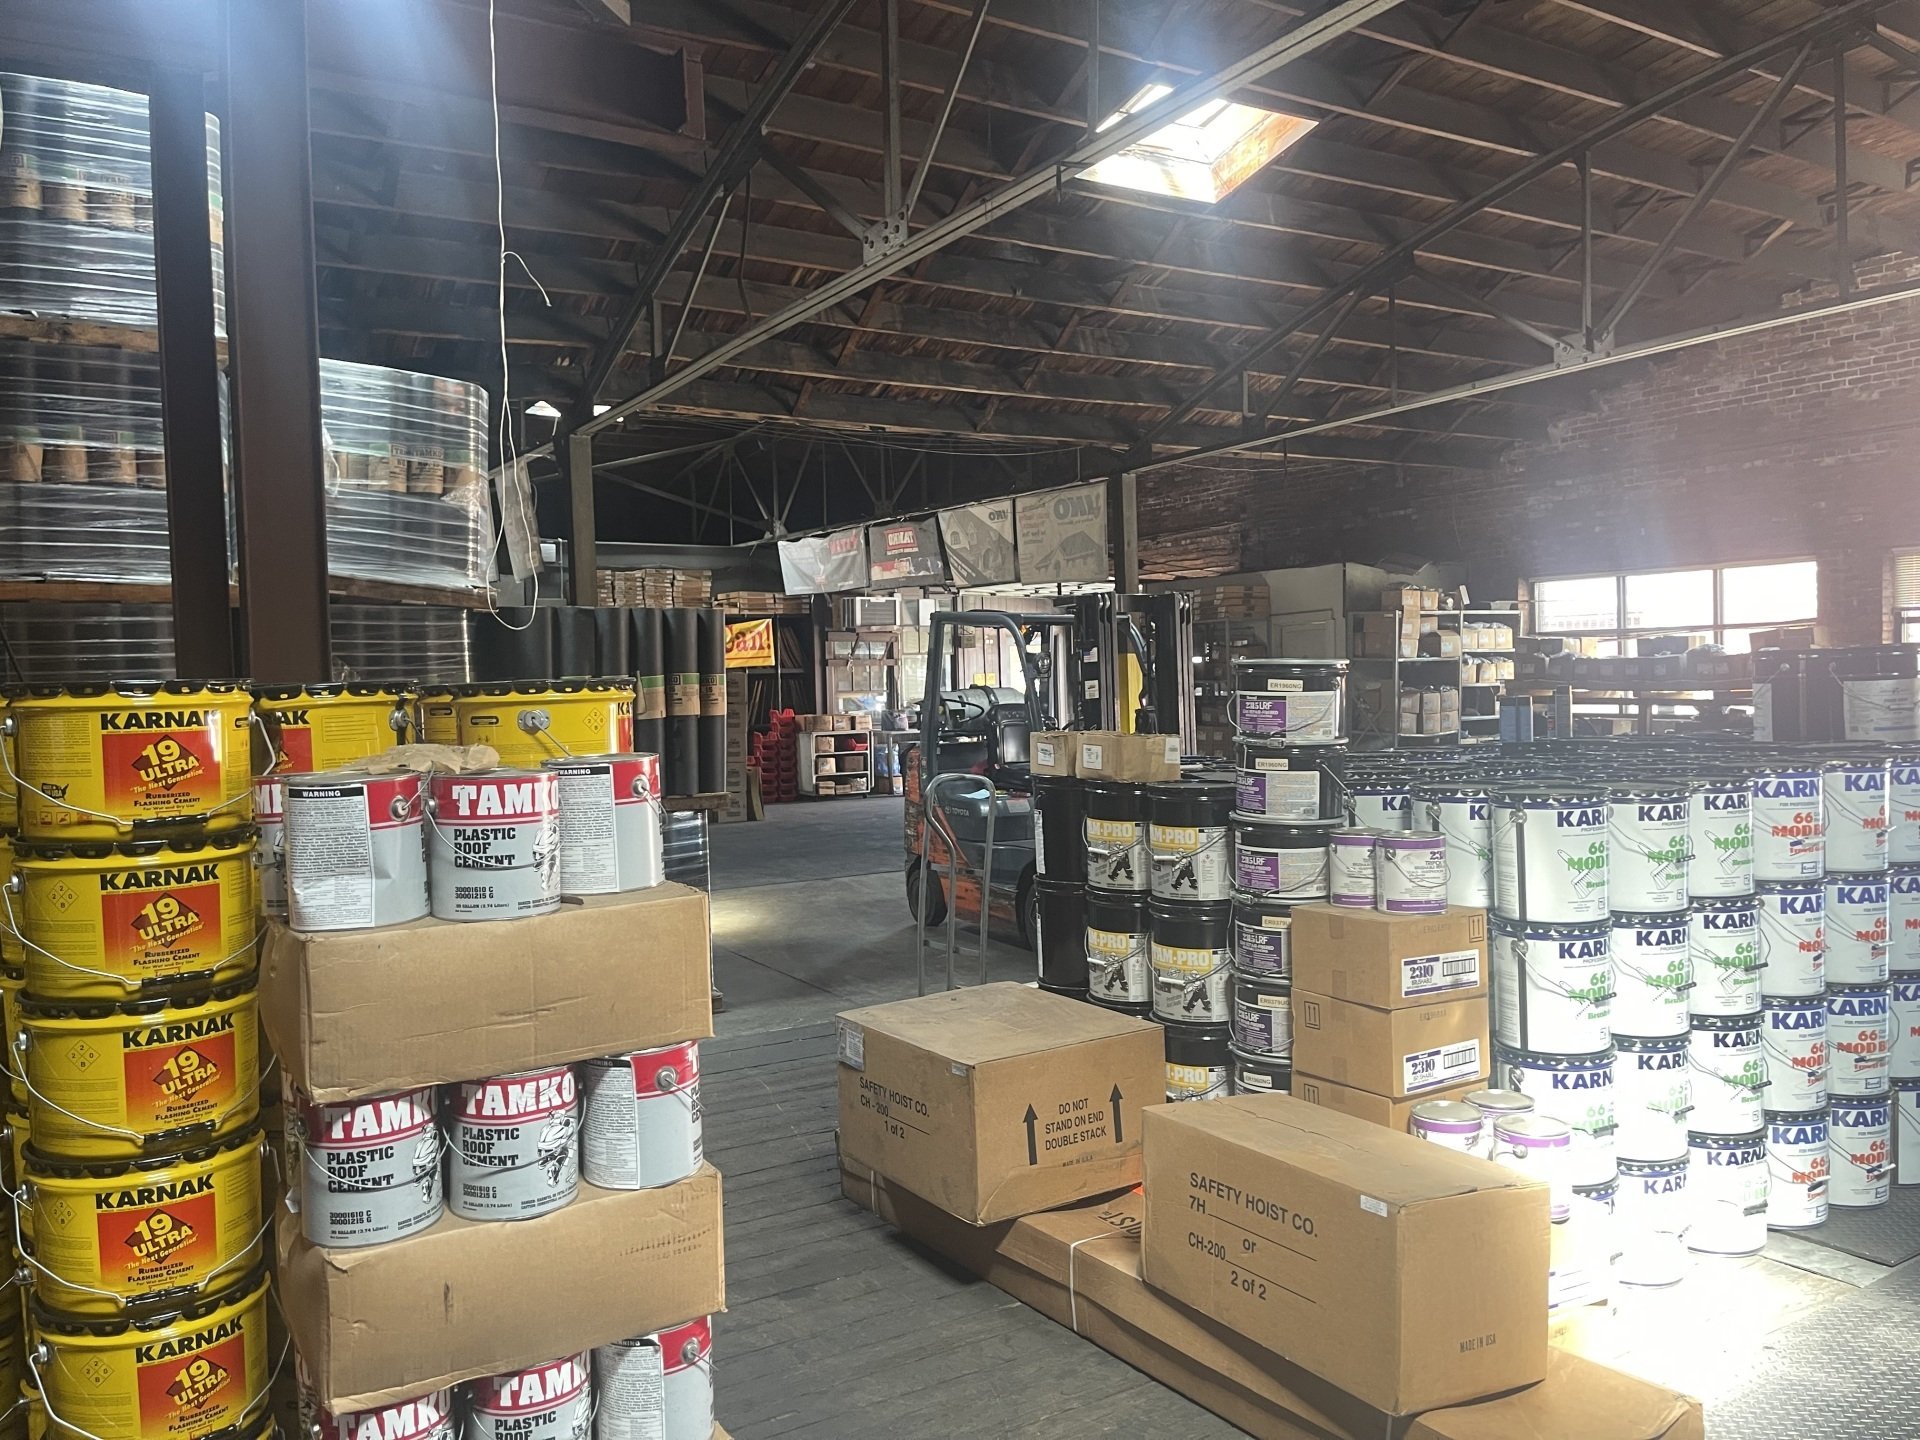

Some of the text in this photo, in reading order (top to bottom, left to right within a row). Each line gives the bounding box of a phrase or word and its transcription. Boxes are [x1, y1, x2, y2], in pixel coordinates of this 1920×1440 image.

[142, 739, 180, 766] 19
[139, 755, 200, 782] ULTRA
[173, 797, 201, 805] CEMENT
[302, 790, 341, 798] WARNING
[952, 807, 970, 816] TOYOTA
[1793, 811, 1814, 824] 66
[454, 827, 516, 841] PLASTIC
[1734, 823, 1750, 835] 66
[454, 842, 491, 855] ROOF
[1588, 840, 1605, 856] 66
[1669, 834, 1685, 848] 66
[454, 854, 516, 868] CEMENT
[100, 863, 220, 890] KARNAK
[141, 897, 180, 923] 19
[139, 913, 200, 940] ULTRA
[1735, 941, 1754, 955] 66
[133, 952, 201, 966] FLASHING CEMENT
[1667, 959, 1685, 973] 66
[1410, 965, 1434, 979] 2310
[1590, 971, 1606, 986] 66
[123, 1012, 235, 1049] KARNAK
[1858, 1029, 1877, 1041] 66
[163, 1050, 200, 1079] 19
[1411, 1059, 1435, 1075] 2310
[1743, 1059, 1759, 1072] 66
[160, 1062, 217, 1095] ULTRA
[462, 1071, 575, 1116] TAMKO
[860, 1076, 930, 1117] SAFETY HOIST CO.
[155, 1102, 218, 1122] FLASHING CEMENT
[1059, 1098, 1089, 1115] DO NOT
[891, 1124, 898, 1136] of
[900, 1127, 905, 1139] 2
[1045, 1111, 1104, 1134] STAND ON END
[462, 1126, 520, 1140] PLASTIC
[1045, 1125, 1107, 1151] DOUBLE STACK
[327, 1146, 395, 1165] PLASTIC
[462, 1139, 495, 1154] ROOF
[1870, 1140, 1886, 1152] 66
[462, 1153, 519, 1167] CEMENT
[1810, 1157, 1825, 1169] 66
[327, 1165, 368, 1179] ROOF
[96, 1173, 214, 1209] KARNAK
[328, 1173, 394, 1193] CEMENT
[1189, 1194, 1206, 1215] 7H
[1190, 1172, 1318, 1238] SAFETY HOIST CO.
[134, 1213, 173, 1242] 19
[133, 1224, 193, 1257] ULTRA
[1188, 1231, 1226, 1261] CH-200
[1243, 1238, 1257, 1253] or
[128, 1264, 195, 1283] FLASHING CEMENT
[1231, 1270, 1267, 1301] 2 of 2
[136, 1314, 244, 1364] KARNAK
[1459, 1333, 1496, 1353] MADE IN USA
[175, 1359, 211, 1389] 19
[173, 1368, 228, 1406] ULTRA
[169, 1406, 229, 1431] FLASHING CEMENT
[494, 1411, 557, 1431] PLASTIC
